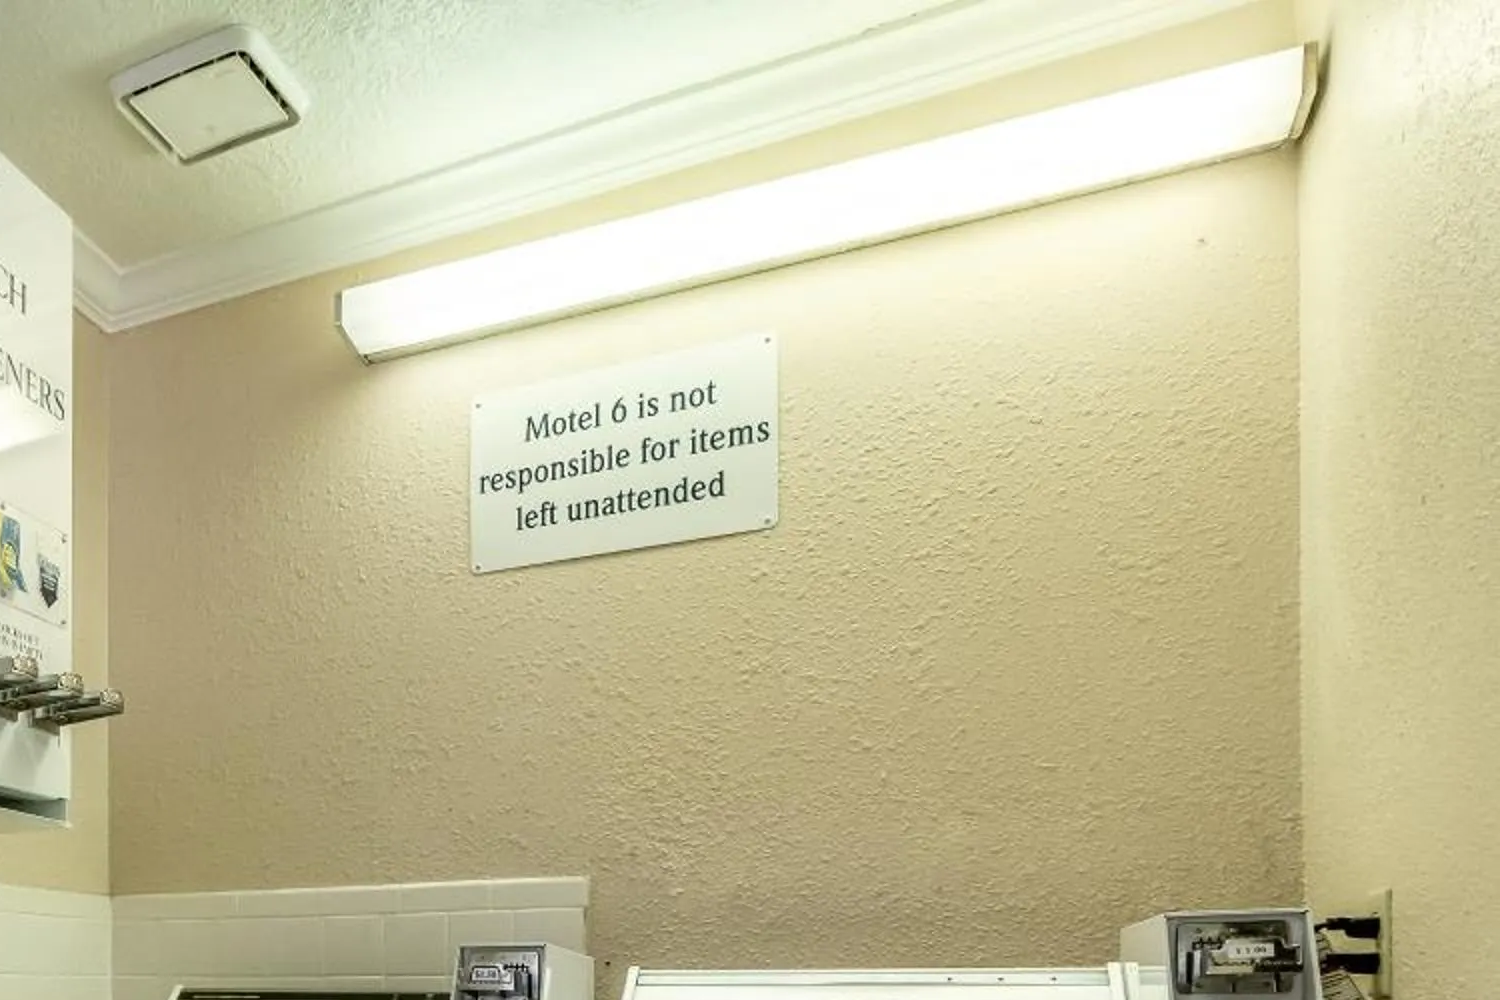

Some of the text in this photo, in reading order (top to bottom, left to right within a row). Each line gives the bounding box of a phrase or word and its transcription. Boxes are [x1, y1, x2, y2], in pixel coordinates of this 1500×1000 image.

[525, 380, 717, 442] Motel 6 is not
[479, 420, 770, 494] responsible for items
[516, 470, 726, 530] left unattended
